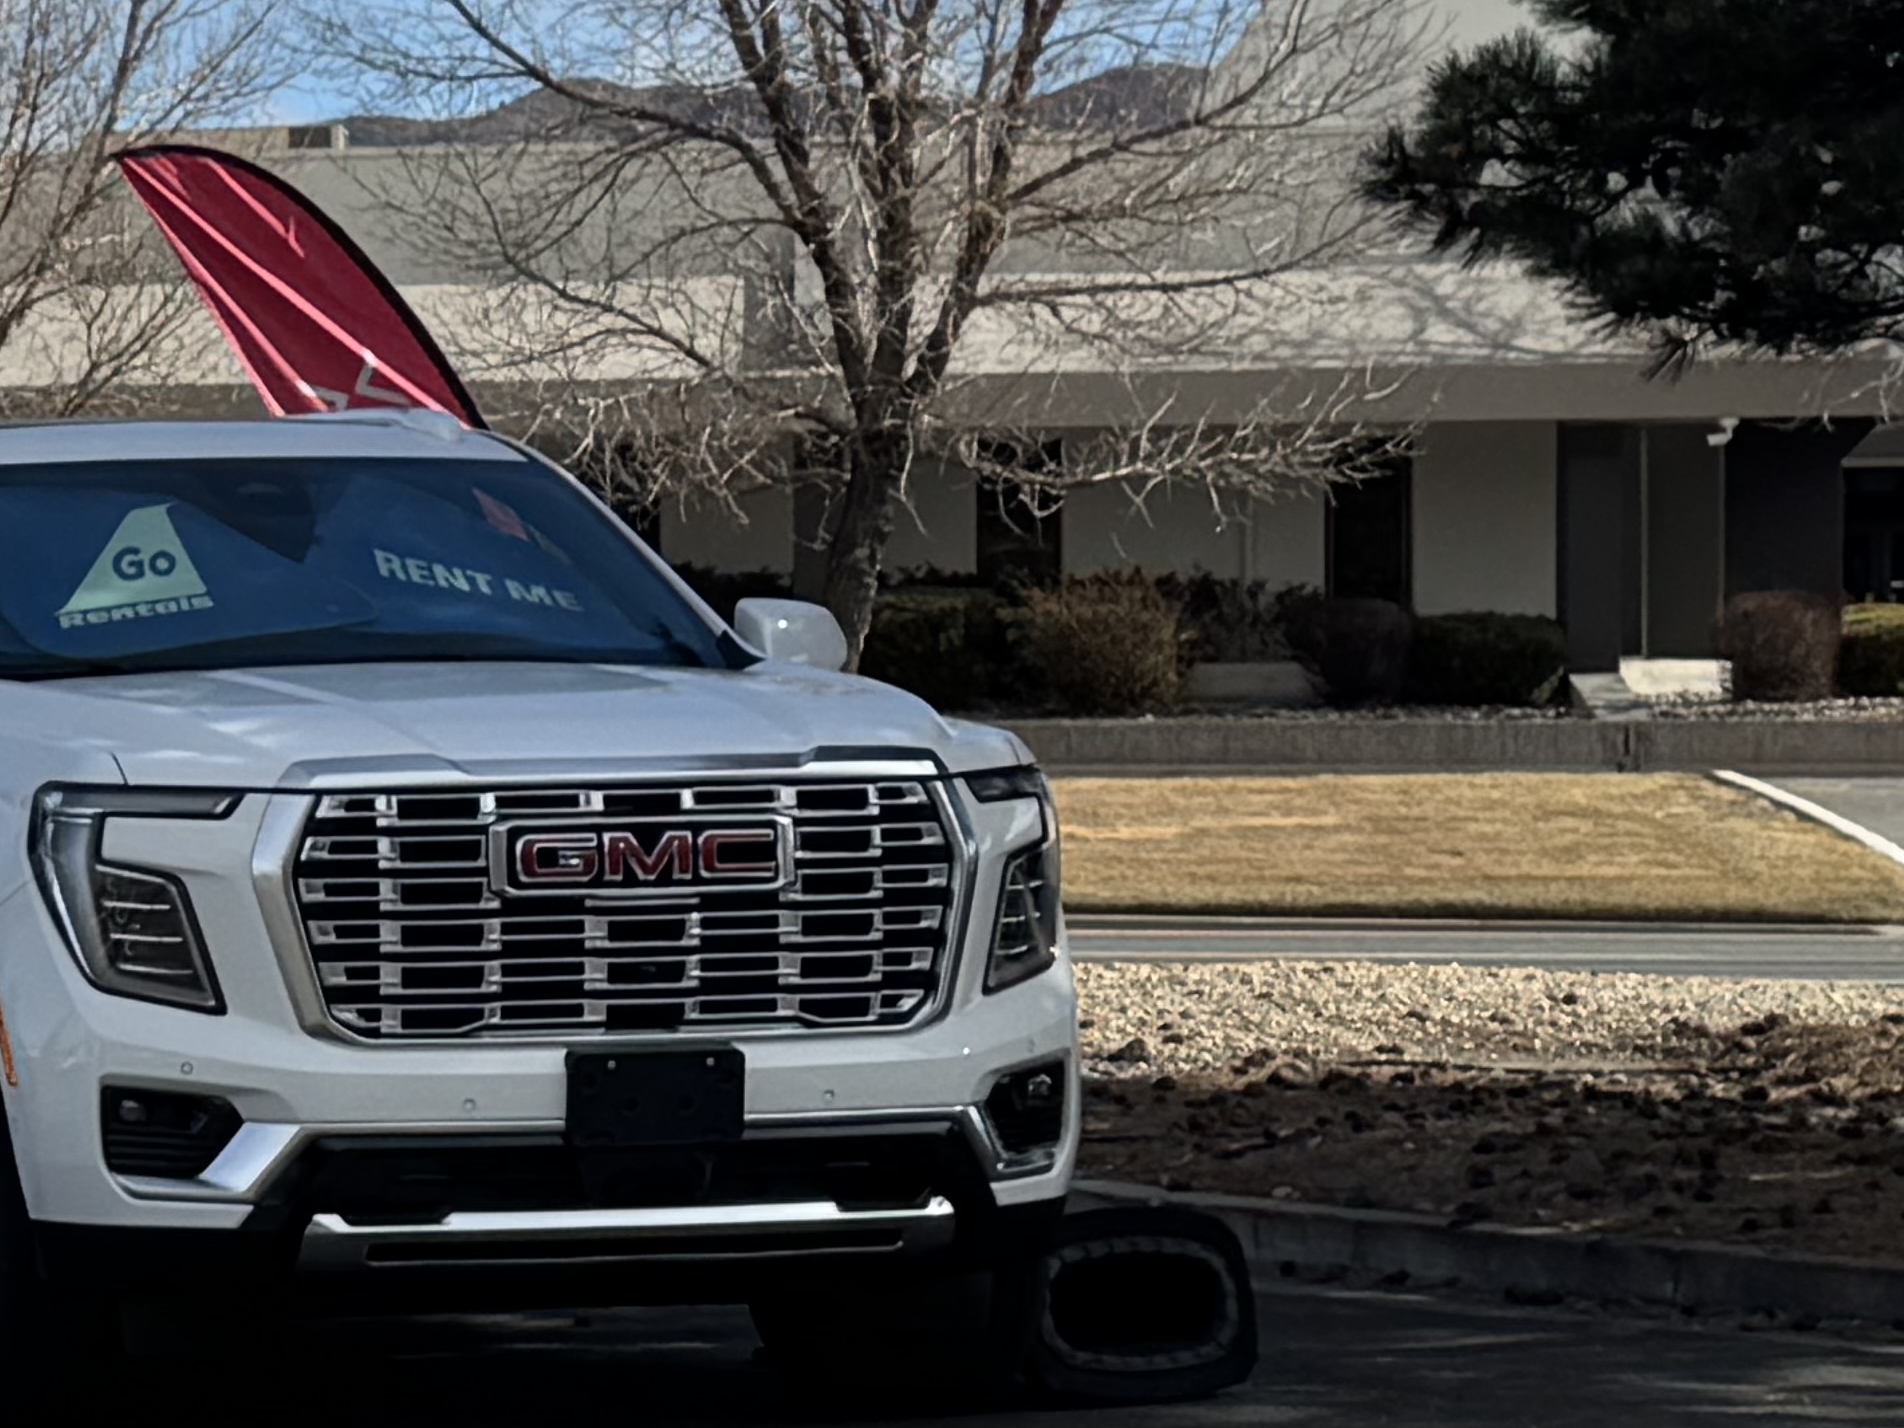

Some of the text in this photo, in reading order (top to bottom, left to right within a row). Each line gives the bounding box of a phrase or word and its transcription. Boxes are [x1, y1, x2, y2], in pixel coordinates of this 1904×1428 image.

[374, 548, 586, 613] RENT ME
[516, 828, 777, 883] GMC
